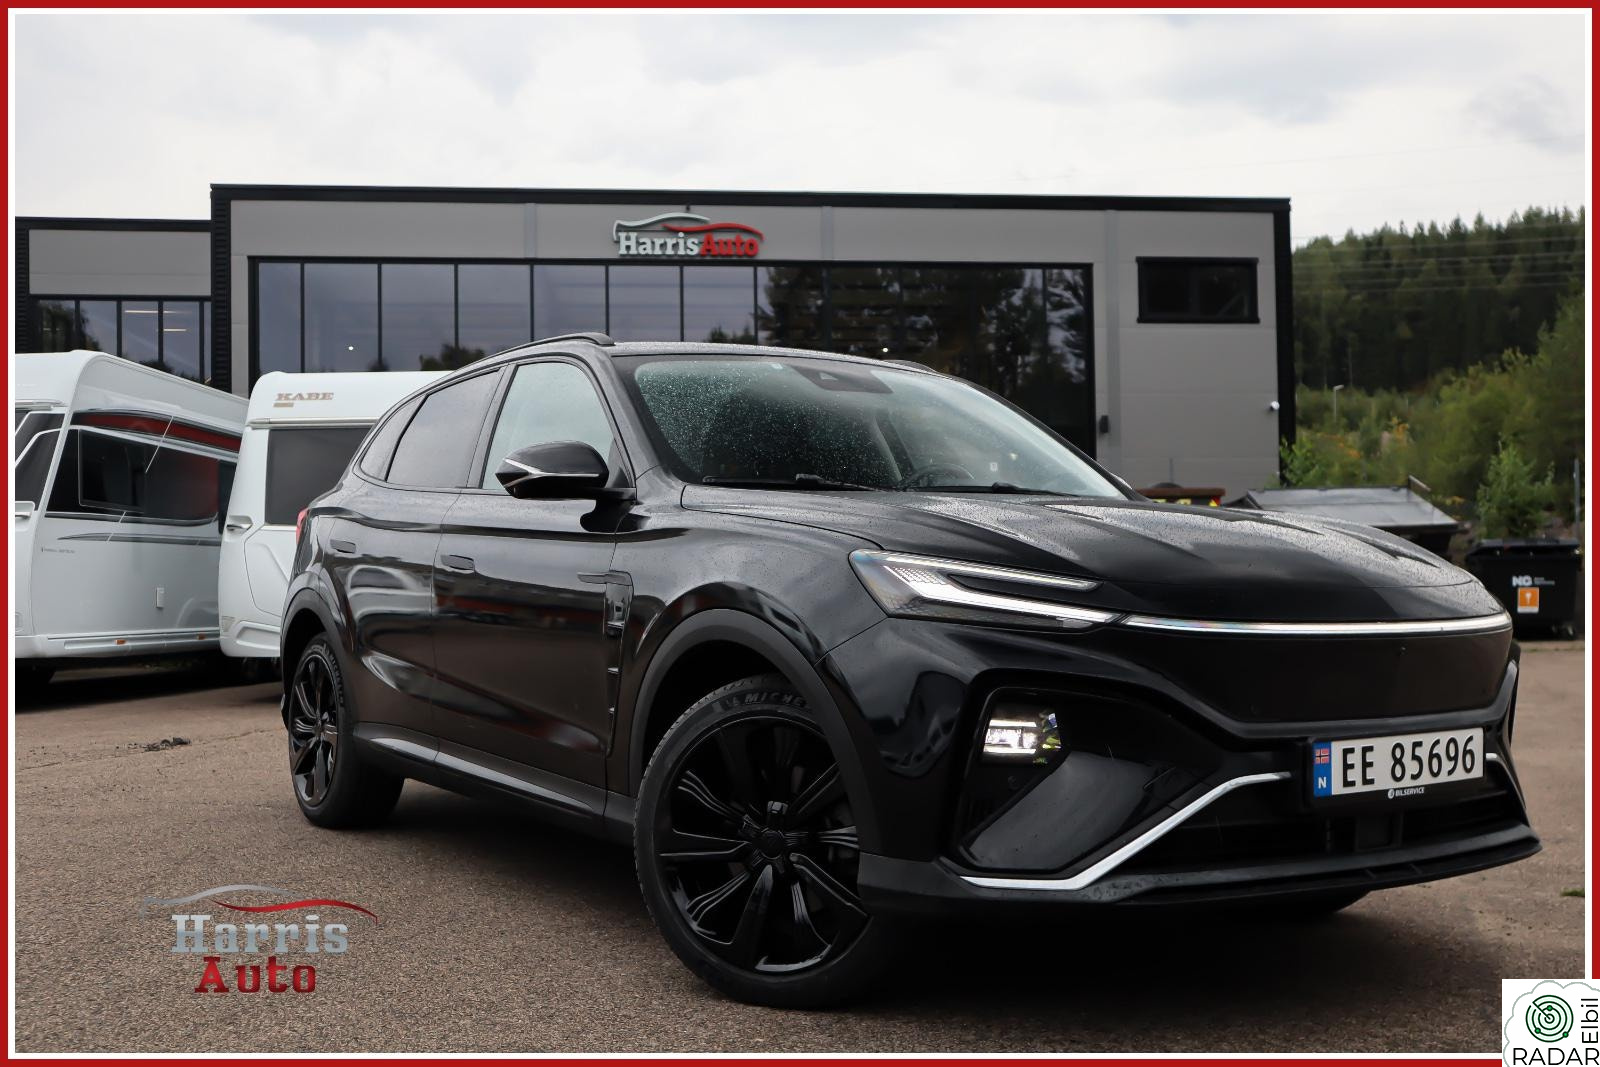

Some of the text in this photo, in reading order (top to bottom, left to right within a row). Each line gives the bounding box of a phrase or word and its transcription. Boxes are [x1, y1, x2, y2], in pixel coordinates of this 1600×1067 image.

[275, 392, 334, 401] KABE
[1342, 735, 1475, 788] EE 85696
[1318, 776, 1327, 789] N
[1395, 786, 1425, 797] BILSERVICE
